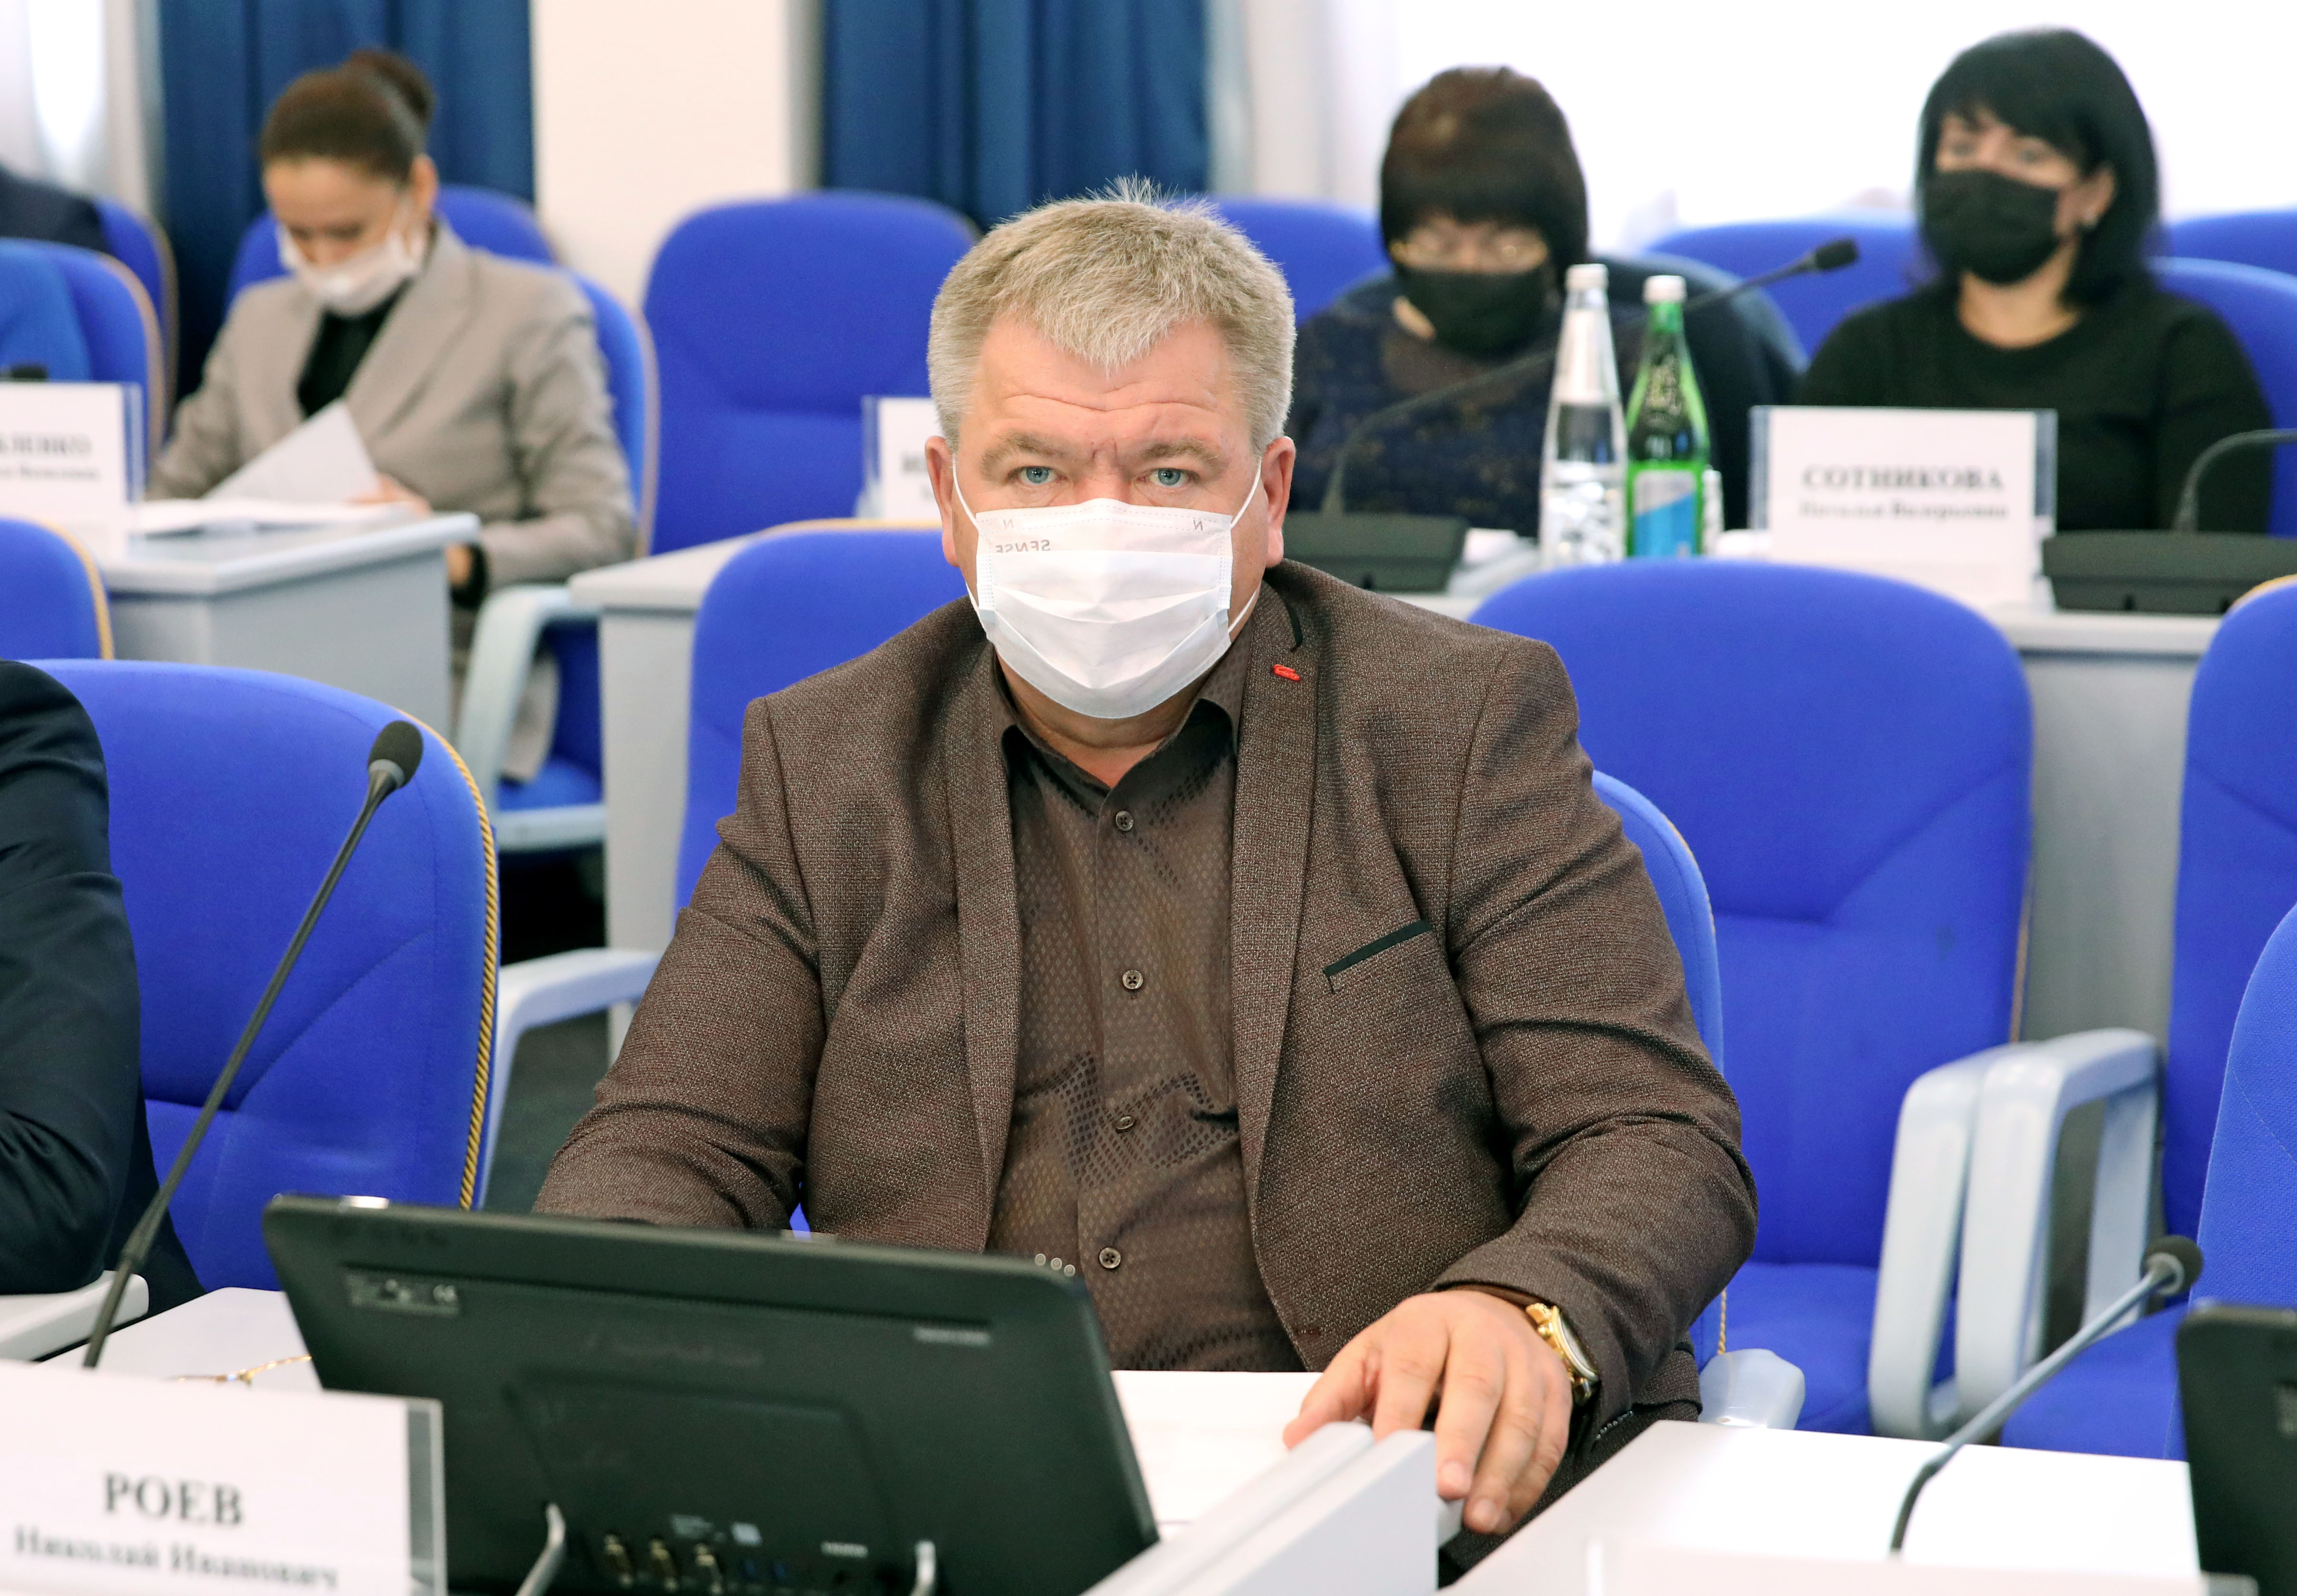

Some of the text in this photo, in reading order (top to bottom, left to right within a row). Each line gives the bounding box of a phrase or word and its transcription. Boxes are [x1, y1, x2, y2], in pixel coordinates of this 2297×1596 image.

[1801, 465, 2005, 490] СОТНИКОВА
[103, 1472, 245, 1526] РОЕВ
[14, 1525, 160, 1569] Николай
